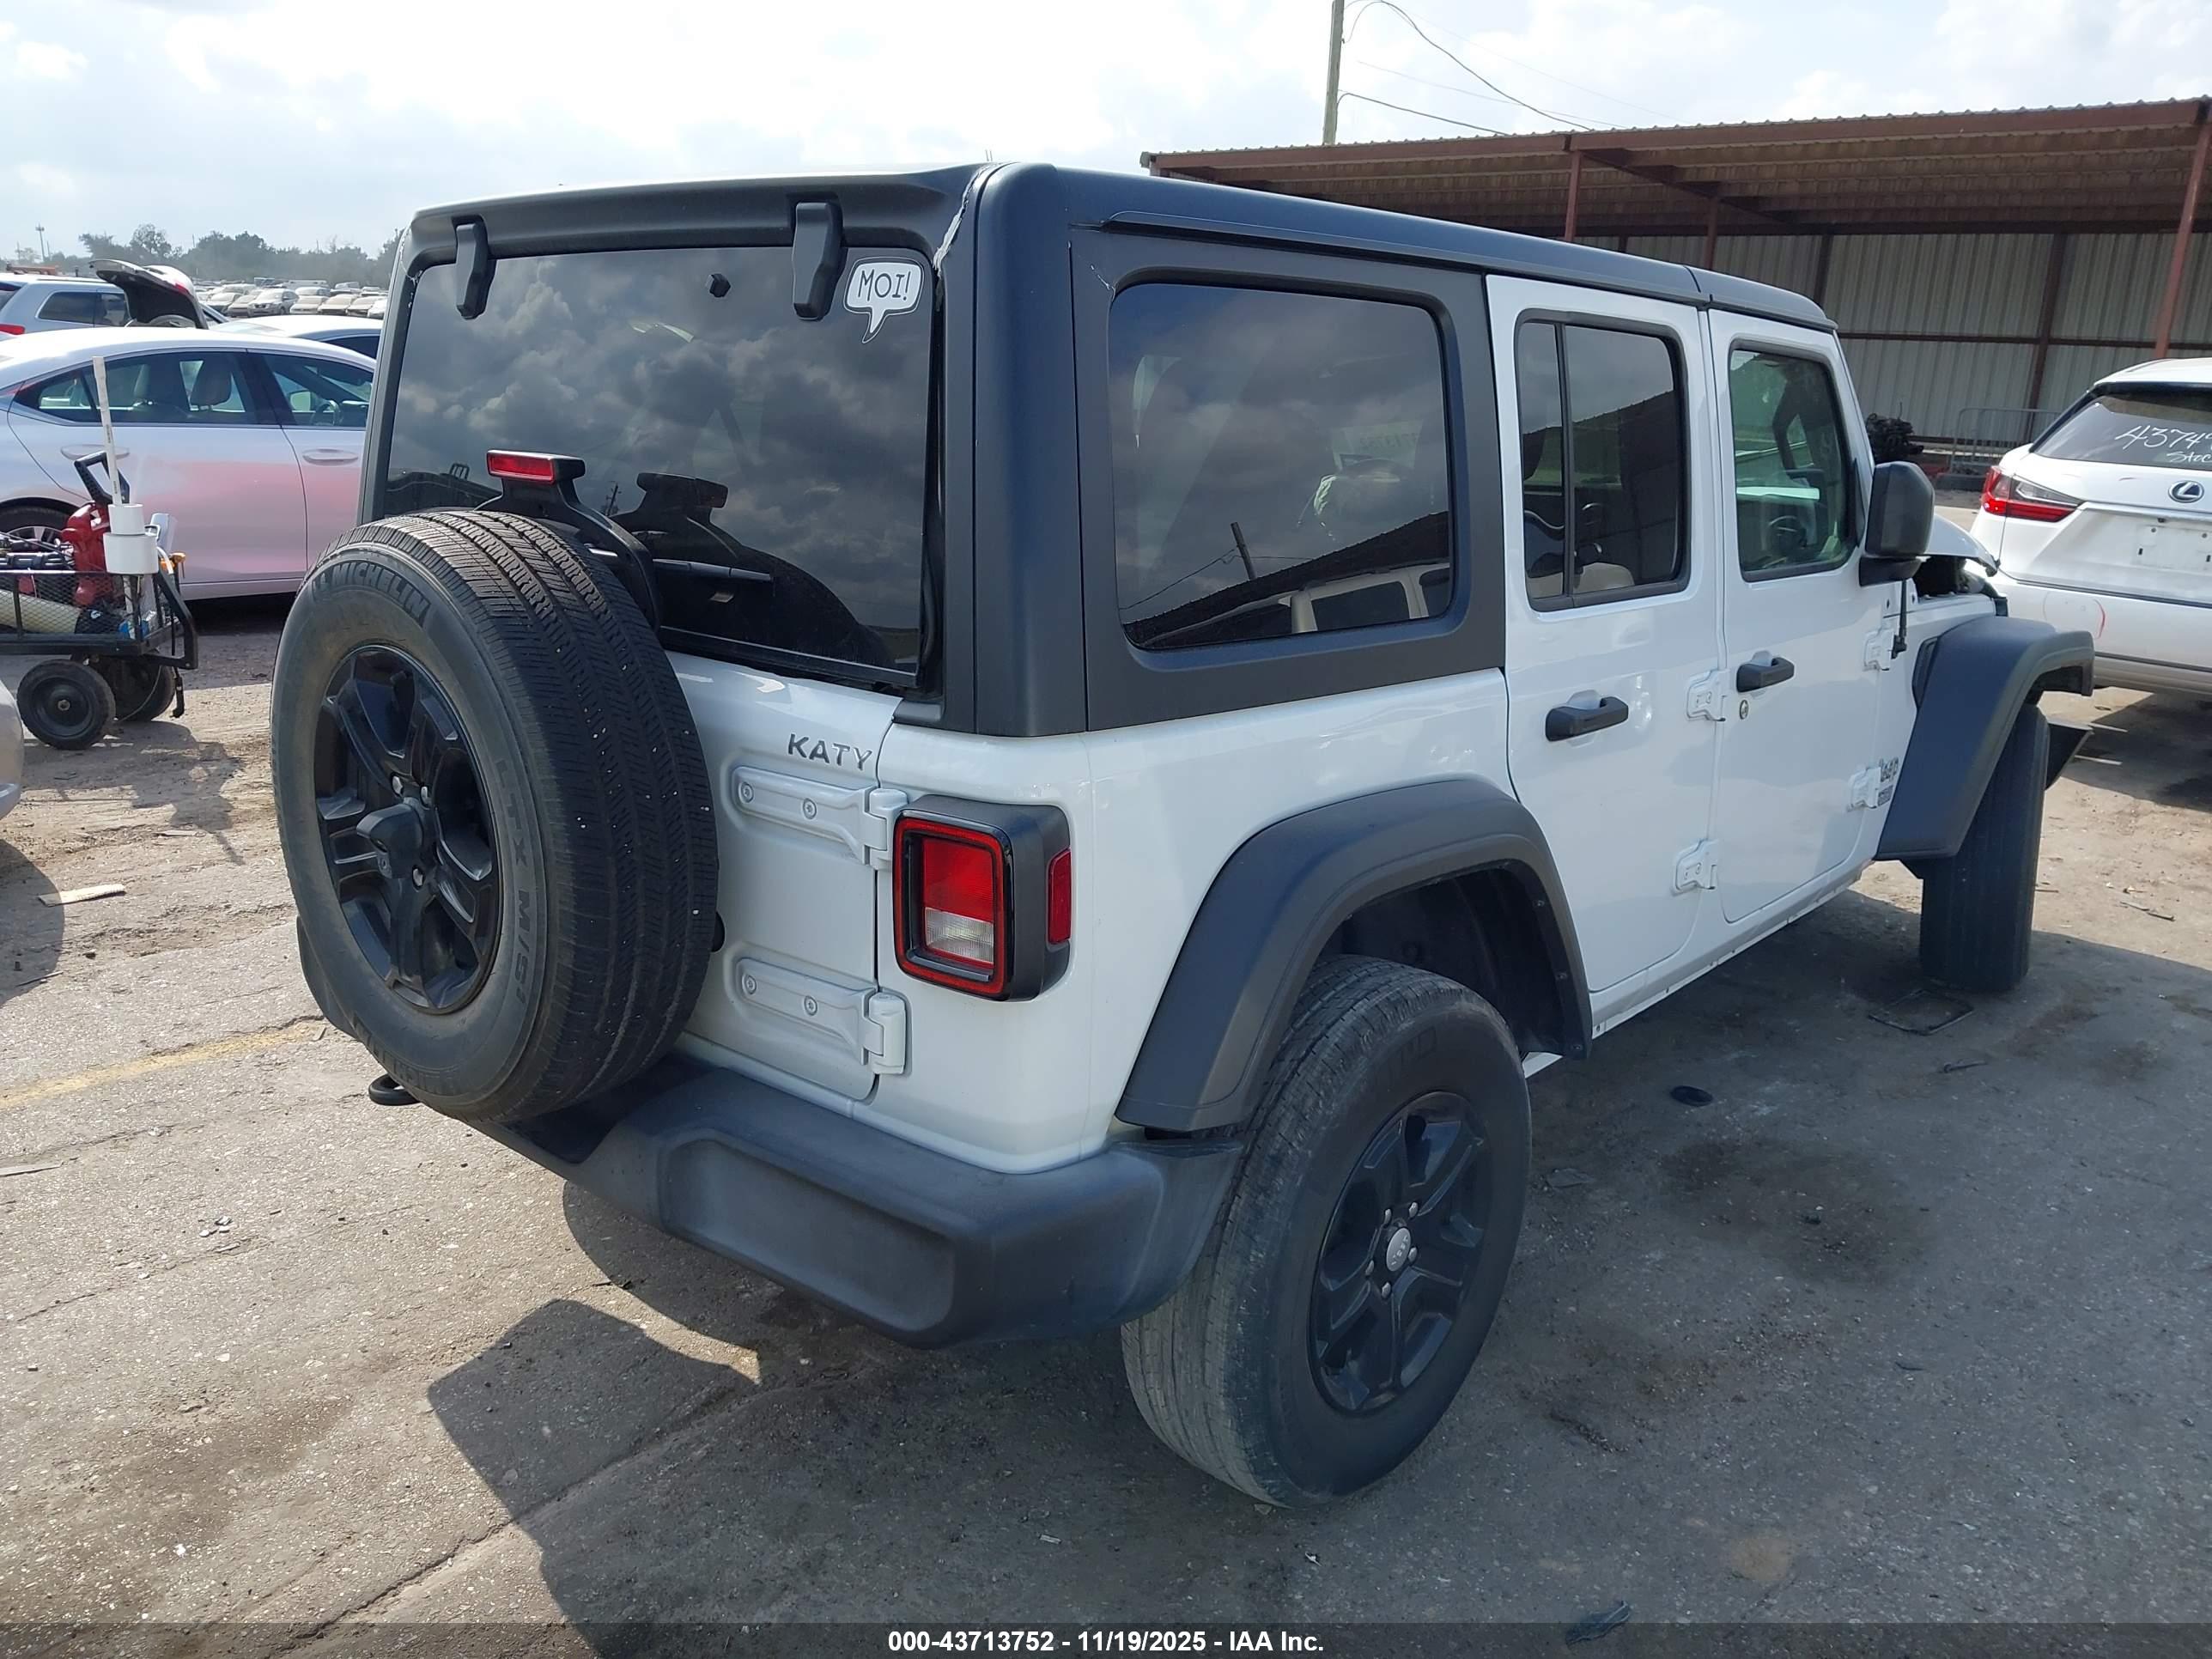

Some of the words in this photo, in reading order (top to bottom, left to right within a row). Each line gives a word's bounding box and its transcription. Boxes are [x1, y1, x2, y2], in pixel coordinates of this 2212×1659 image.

[858, 269, 911, 301] MOI!
[331, 562, 431, 628] MICHELIN
[788, 733, 872, 770] KATY
[495, 759, 528, 868] LTX
